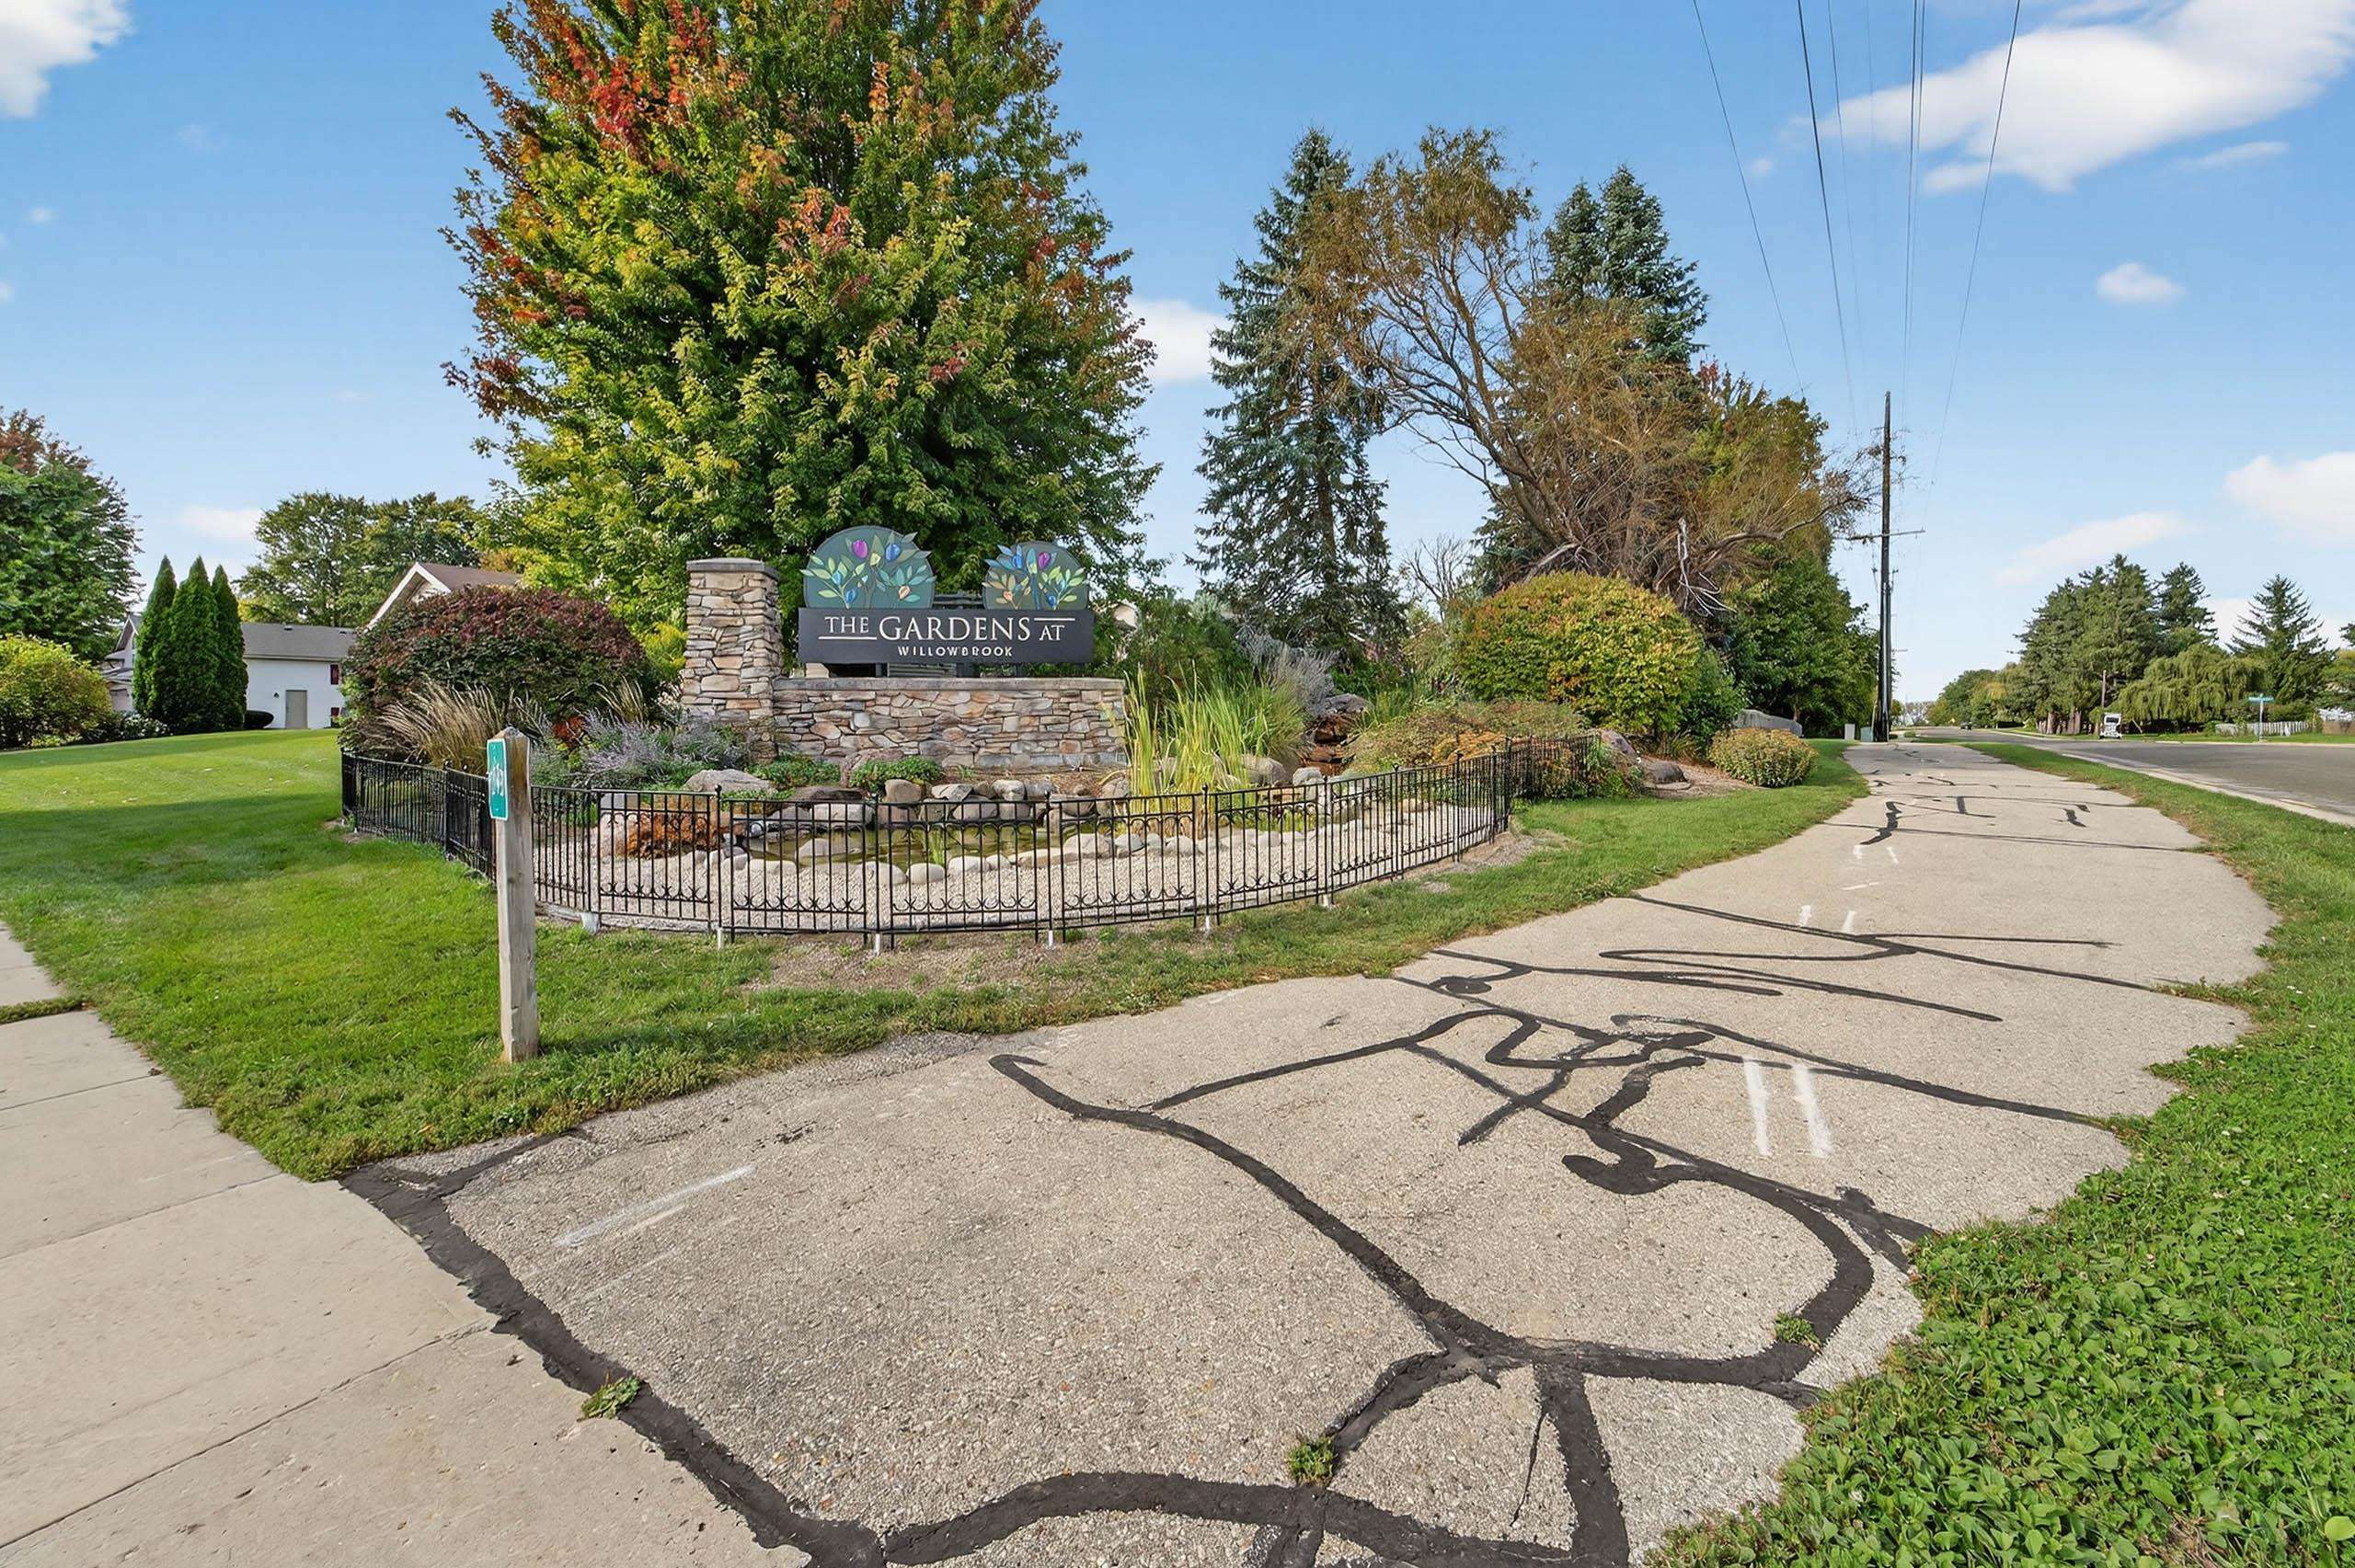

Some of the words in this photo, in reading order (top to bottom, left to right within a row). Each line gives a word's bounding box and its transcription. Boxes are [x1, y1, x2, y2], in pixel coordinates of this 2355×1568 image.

[824, 616, 869, 634] THE
[879, 616, 1031, 642] GARDENS
[1039, 624, 1065, 641] AT
[898, 646, 1013, 657] WILLOWBROOK
